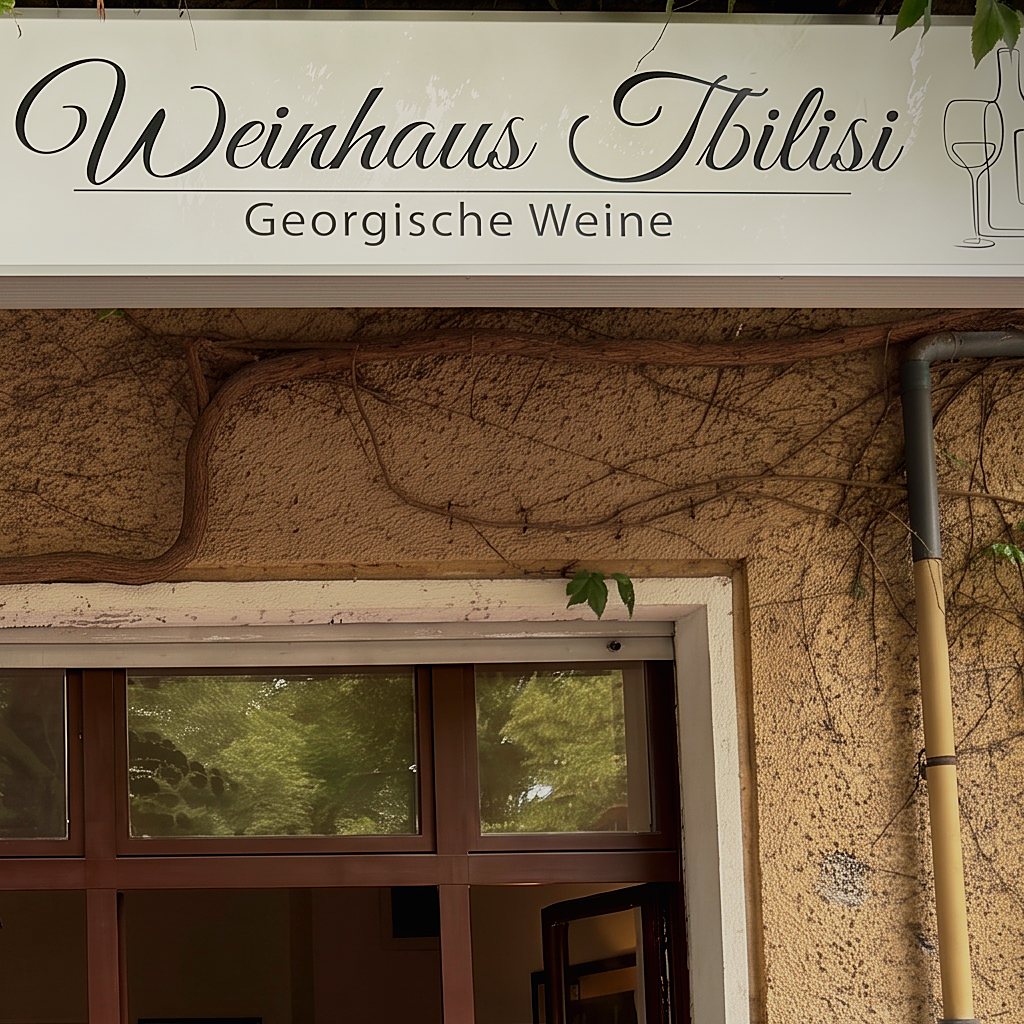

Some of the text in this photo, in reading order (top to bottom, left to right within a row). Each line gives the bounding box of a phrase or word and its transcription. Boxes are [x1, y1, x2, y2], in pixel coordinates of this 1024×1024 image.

[15, 58, 905, 186] Weinhaus Tbilisi
[245, 202, 673, 247] Georgische Weine
